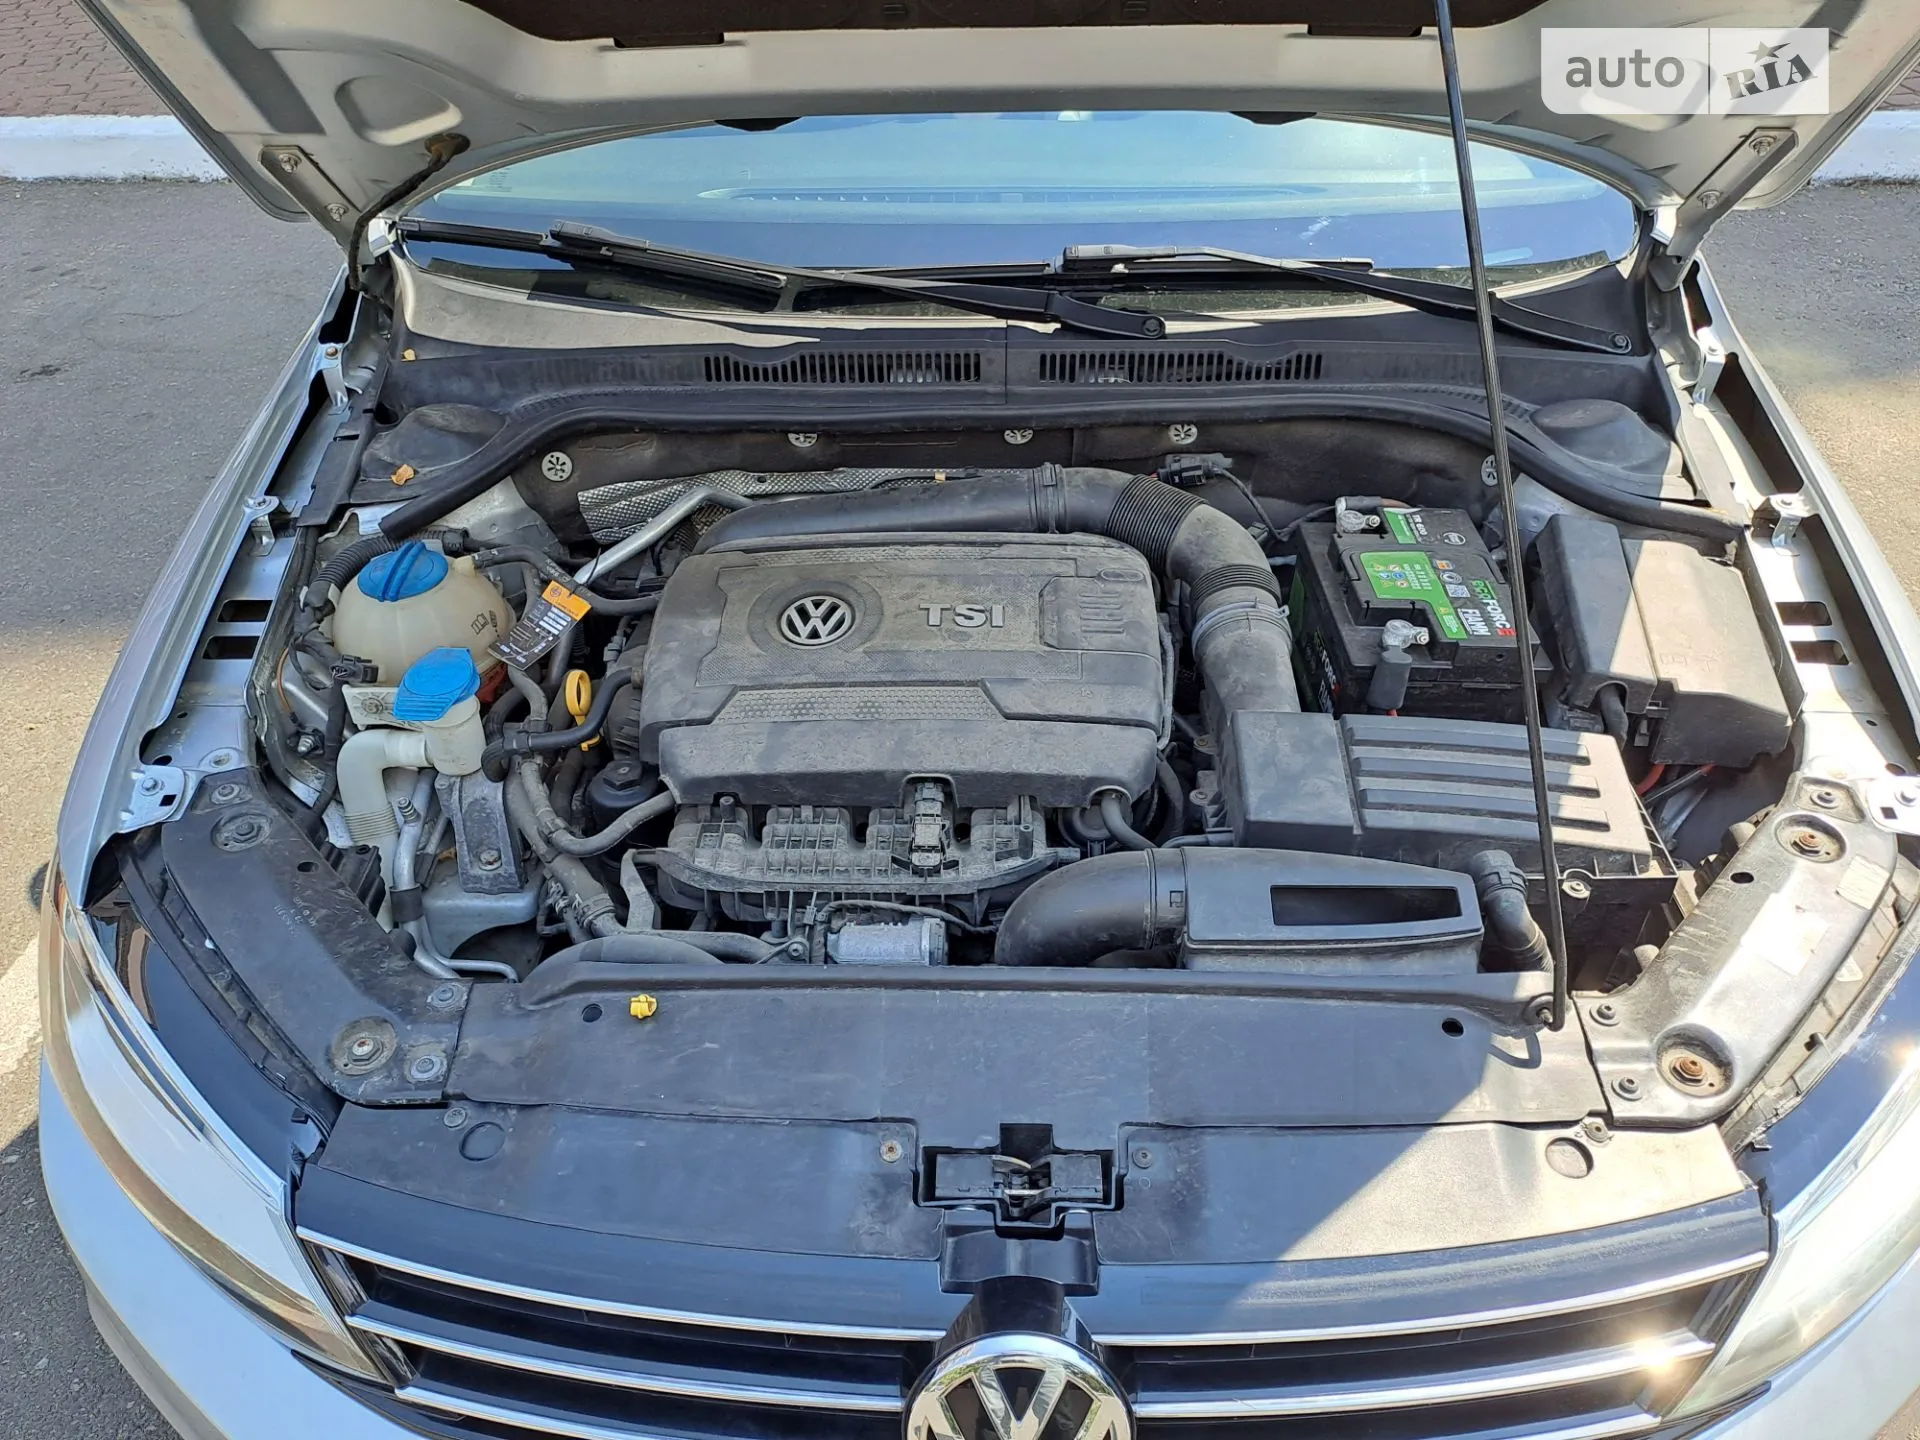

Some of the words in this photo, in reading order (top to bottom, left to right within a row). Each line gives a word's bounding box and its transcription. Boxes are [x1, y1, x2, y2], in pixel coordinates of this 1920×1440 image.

[781, 596, 854, 645] VW
[919, 603, 1004, 627] TSI
[1460, 608, 1491, 636] FIAMM
